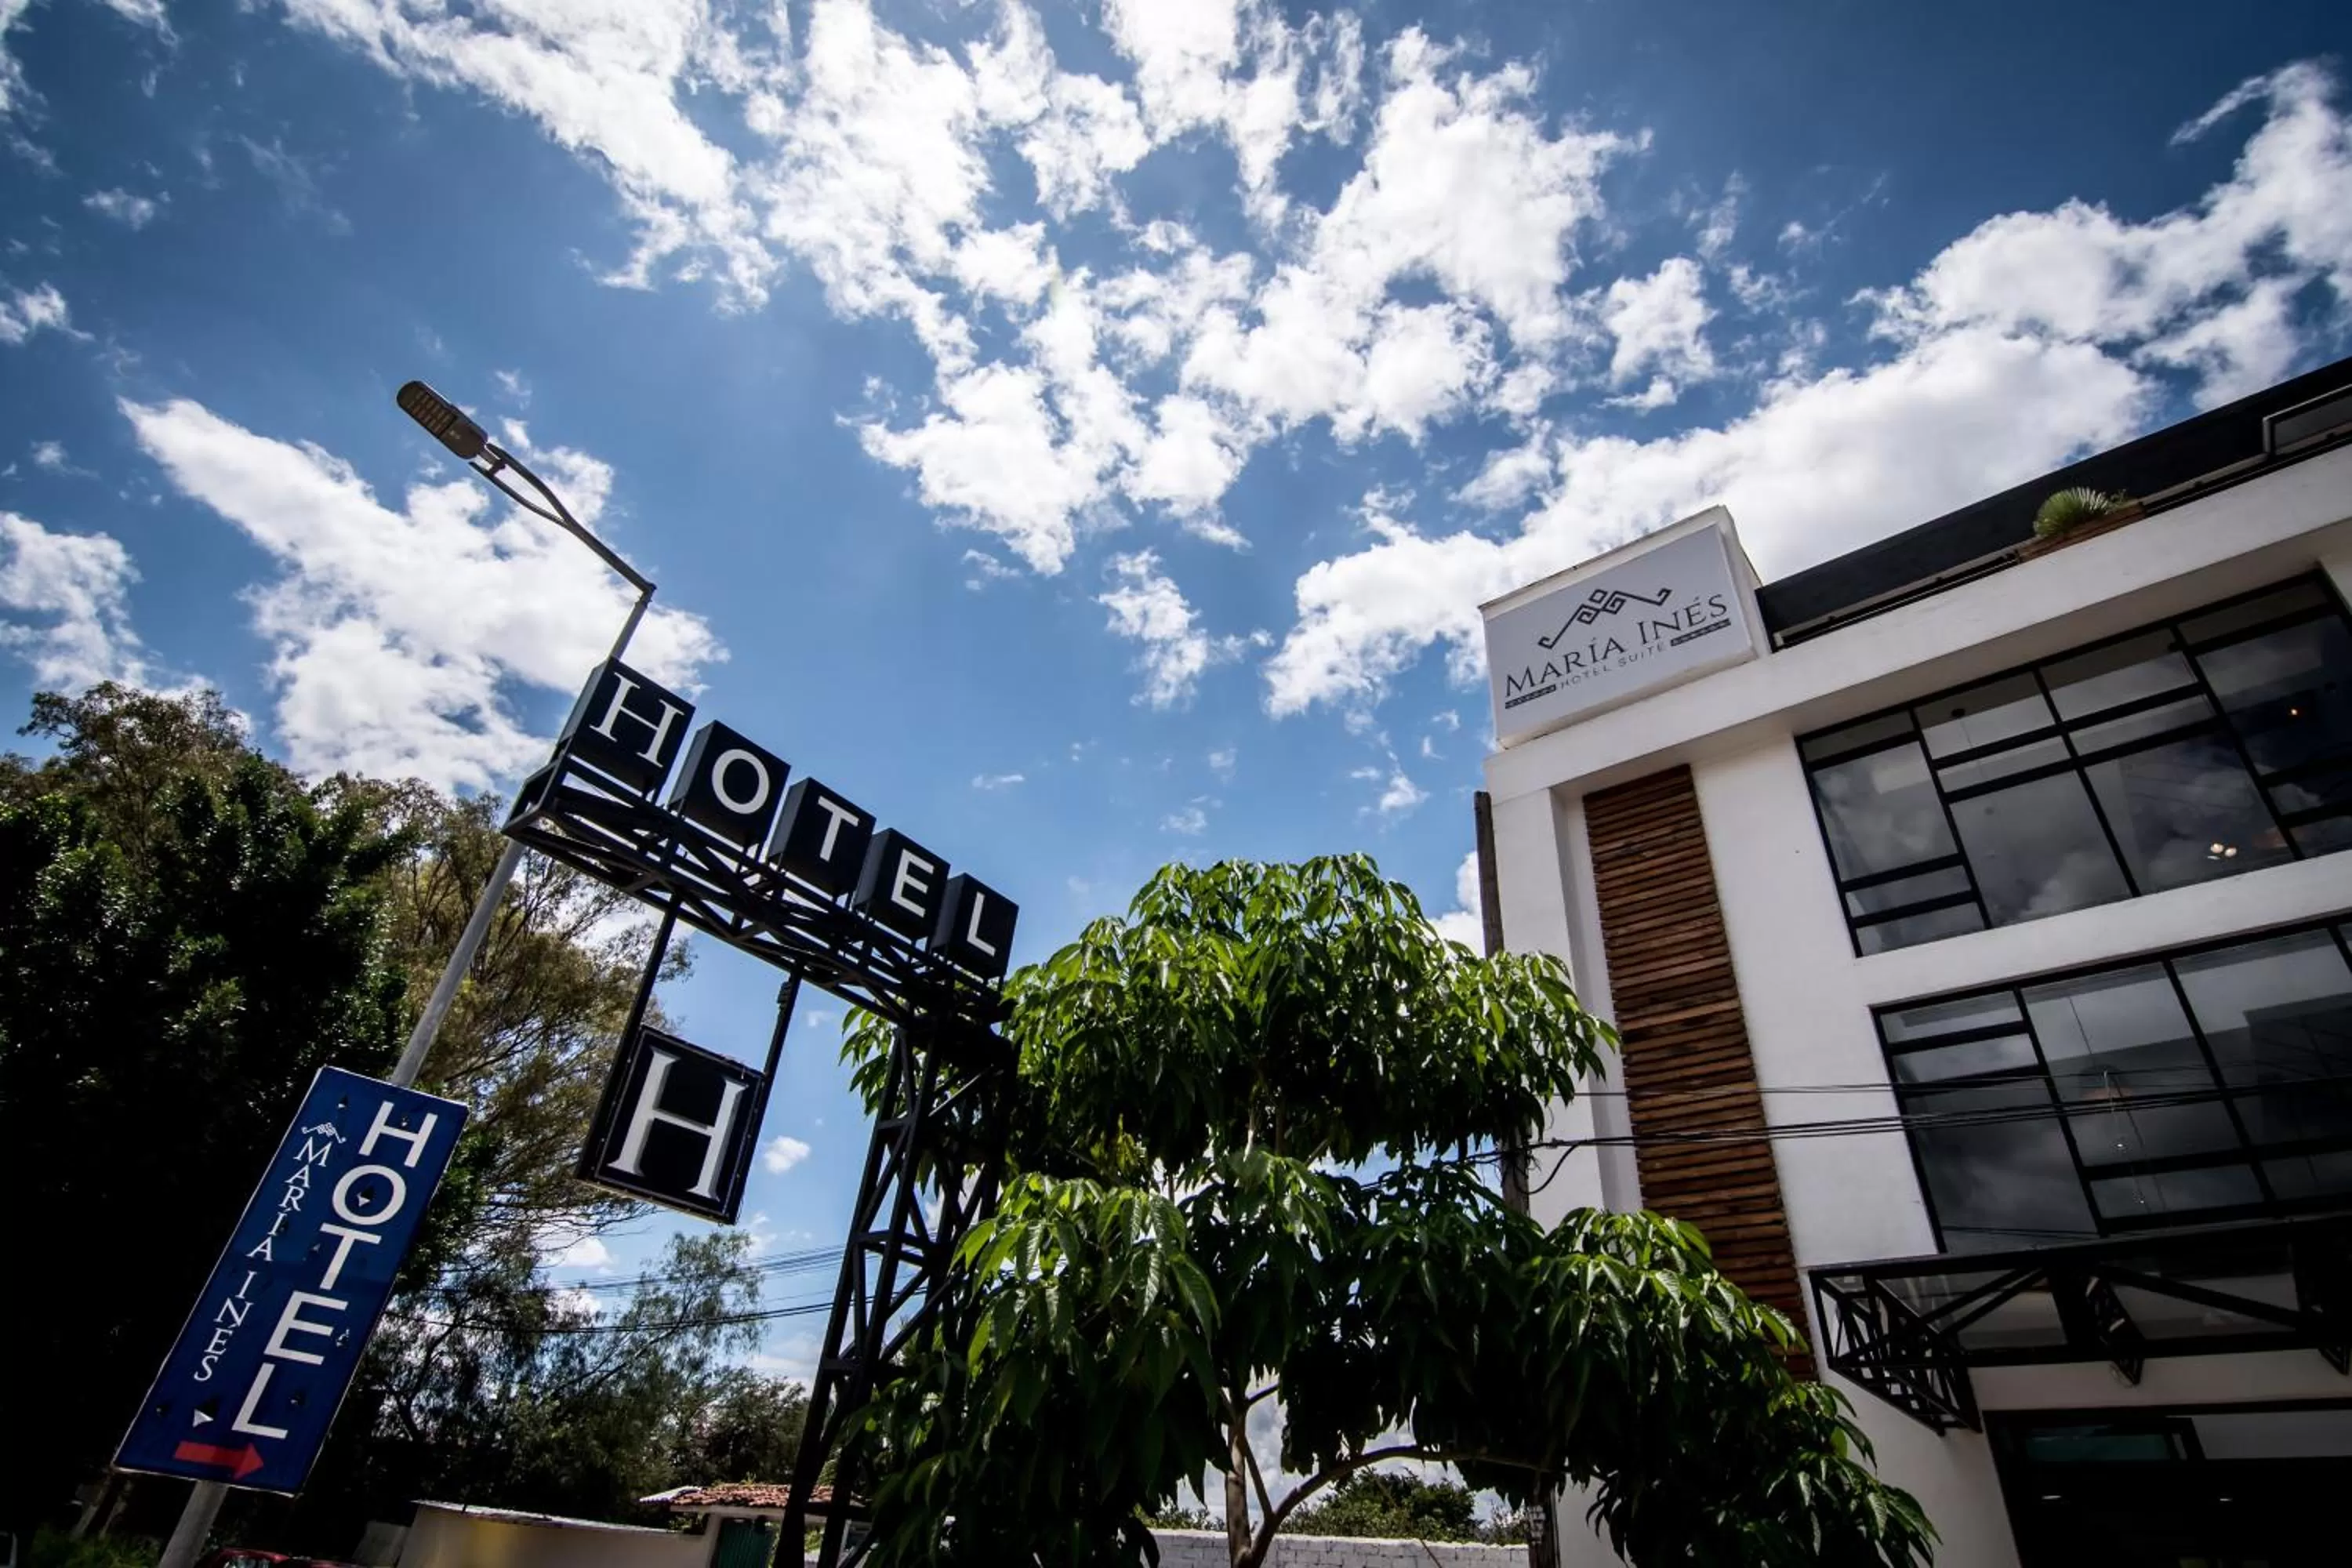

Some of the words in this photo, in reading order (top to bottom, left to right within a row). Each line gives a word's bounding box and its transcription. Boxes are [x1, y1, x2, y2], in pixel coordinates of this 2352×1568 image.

[1505, 637, 1626, 698] MARÍA
[1636, 593, 1728, 645] INÉS
[1560, 665, 1611, 690] HOTEL
[1618, 643, 1664, 667] SUITE
[589, 672, 996, 956] HOTEL
[607, 1046, 749, 1202] H
[246, 1138, 333, 1261] MARÍA
[194, 1271, 256, 1381] INÉS
[231, 1102, 438, 1439] HOTEL
